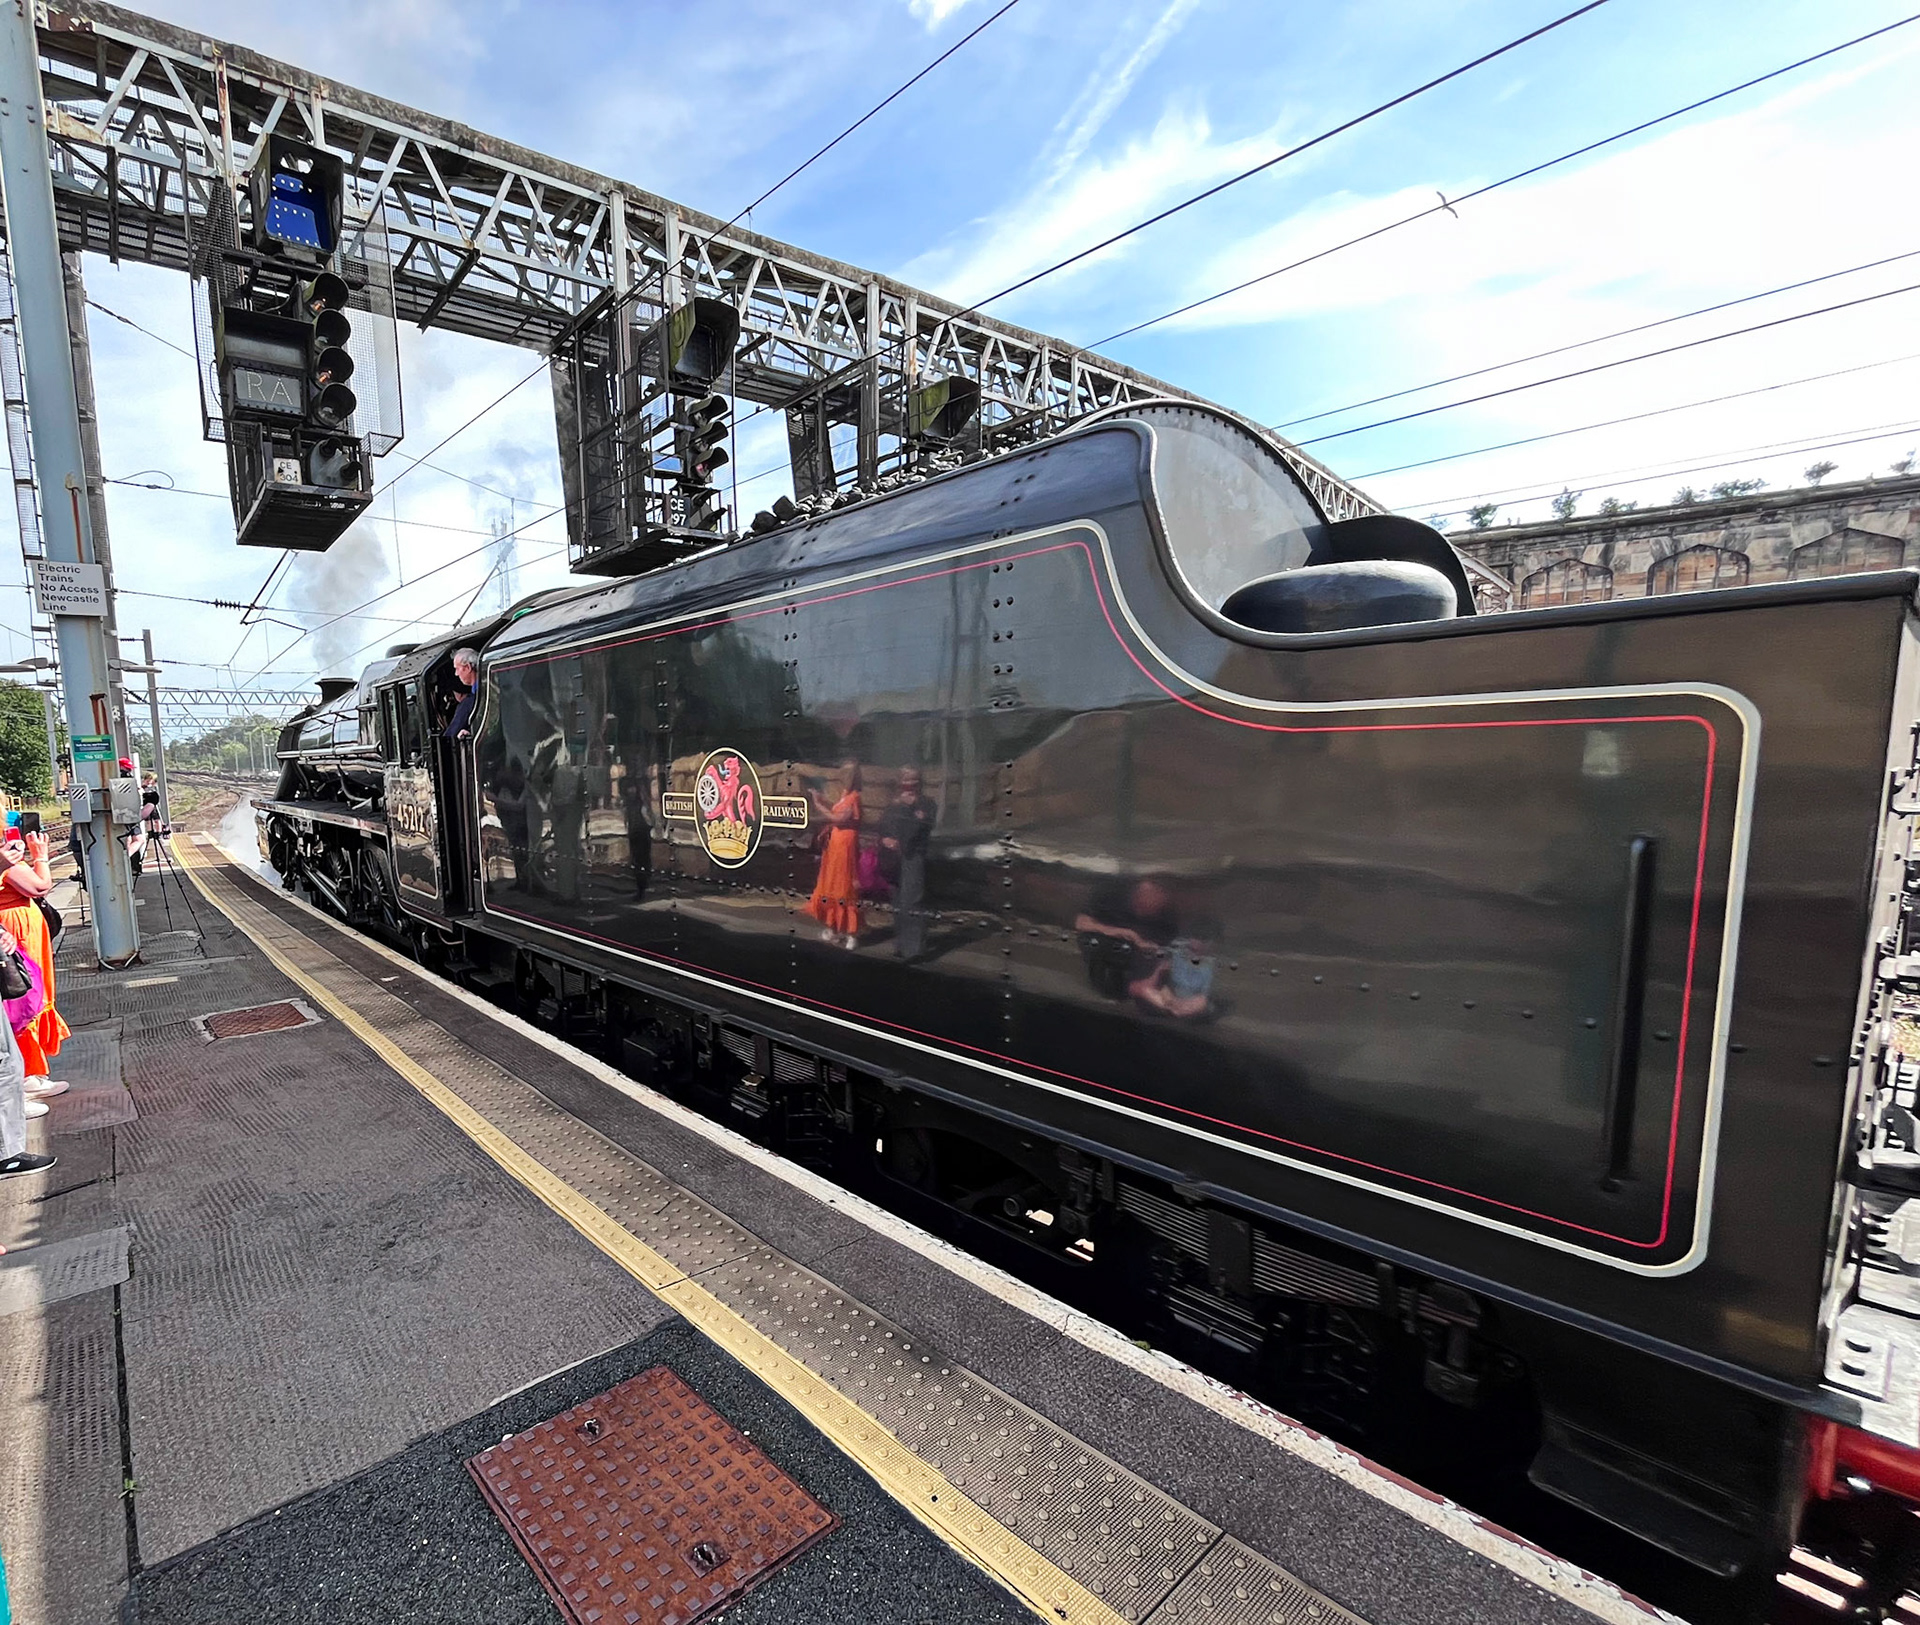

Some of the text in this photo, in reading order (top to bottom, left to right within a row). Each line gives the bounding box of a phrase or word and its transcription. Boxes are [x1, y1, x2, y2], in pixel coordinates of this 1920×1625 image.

[245, 371, 293, 405] RA
[279, 461, 292, 470] CE
[279, 473, 299, 482] 304
[670, 497, 685, 511] CE
[670, 512, 687, 526] 97
[37, 563, 81, 574] Electric
[38, 573, 74, 583] Trains
[40, 583, 100, 594] No Access
[41, 592, 100, 603] Newcastle
[42, 603, 67, 611] Line
[665, 800, 806, 819] BRITISH RAILWAYS
[397, 803, 425, 833] 45212
